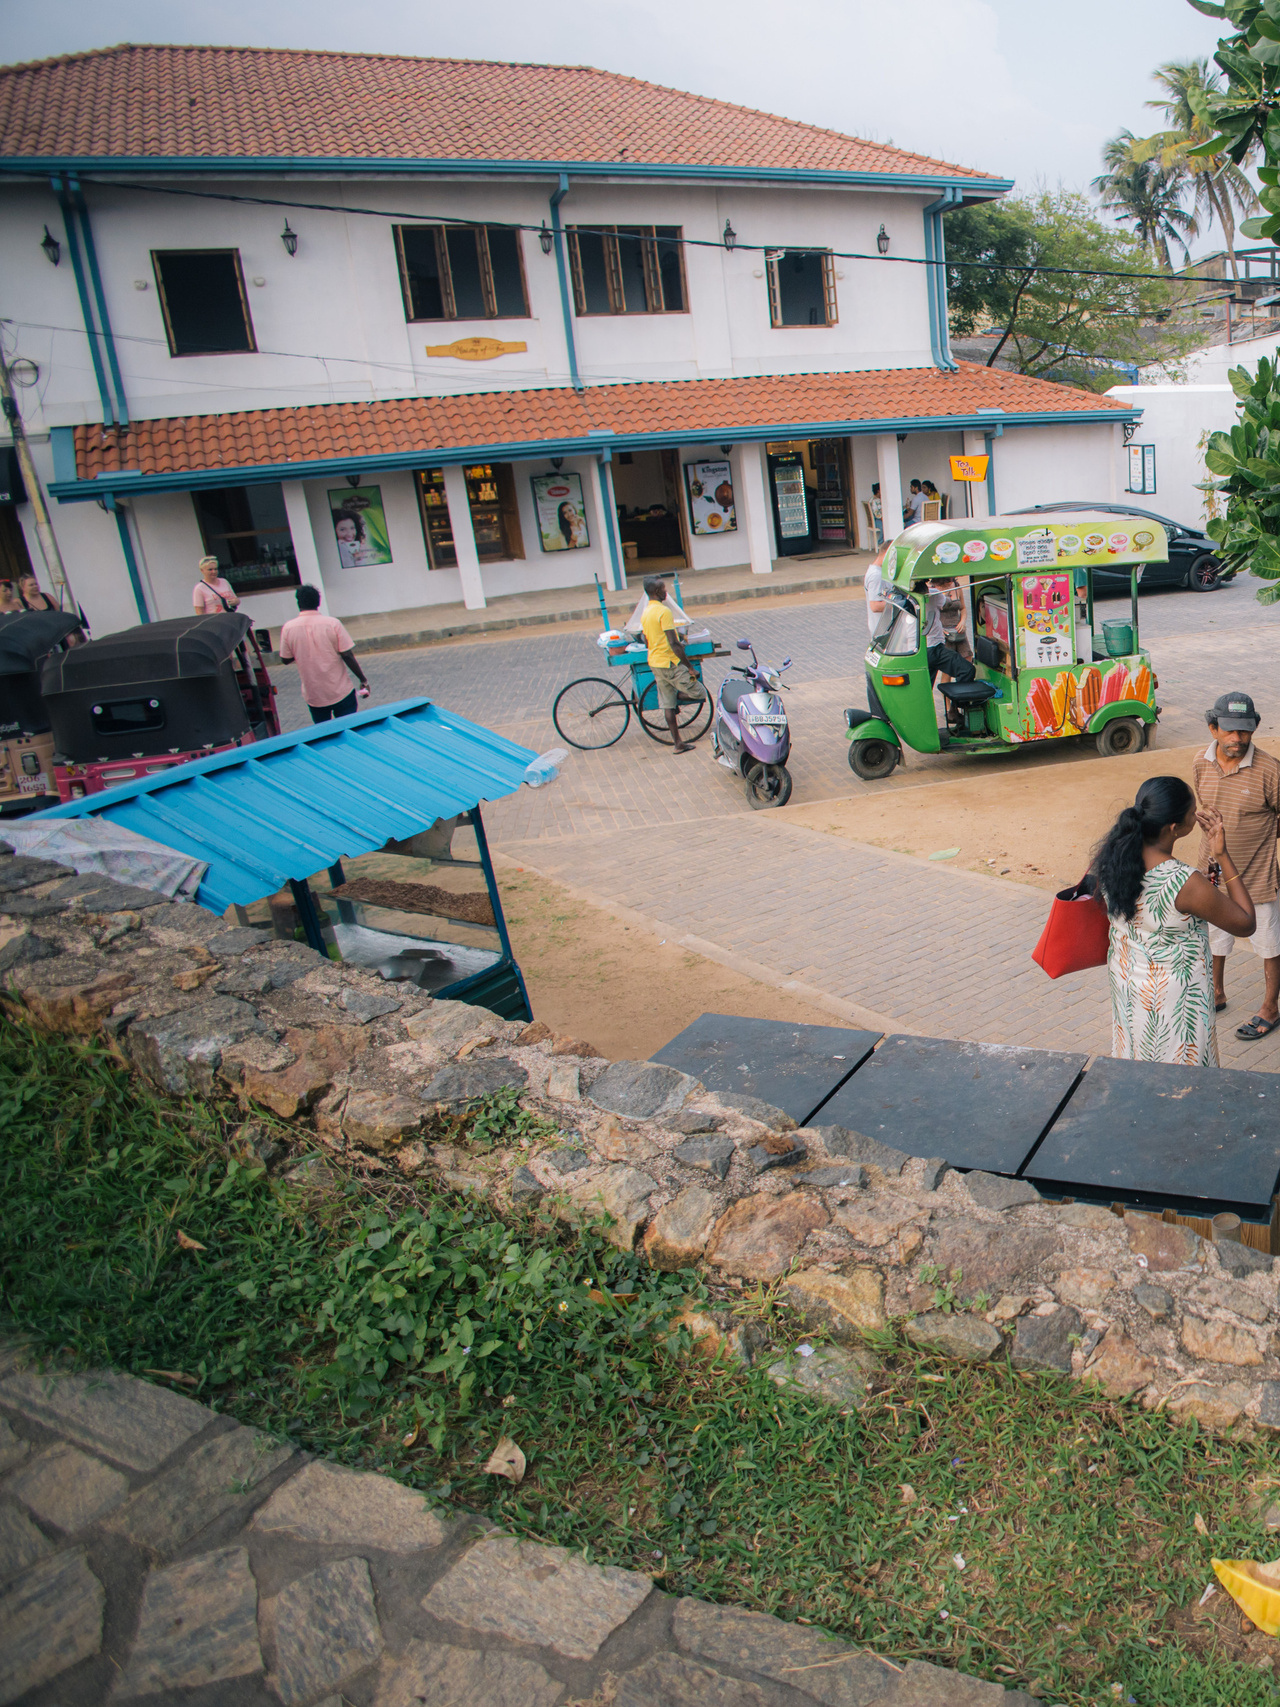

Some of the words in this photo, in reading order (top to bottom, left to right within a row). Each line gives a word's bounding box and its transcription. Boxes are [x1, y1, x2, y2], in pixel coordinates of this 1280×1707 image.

[480, 345, 488, 354] of
[955, 460, 969, 468] Tea
[702, 466, 727, 474] Kingston
[960, 467, 976, 476] Talk
